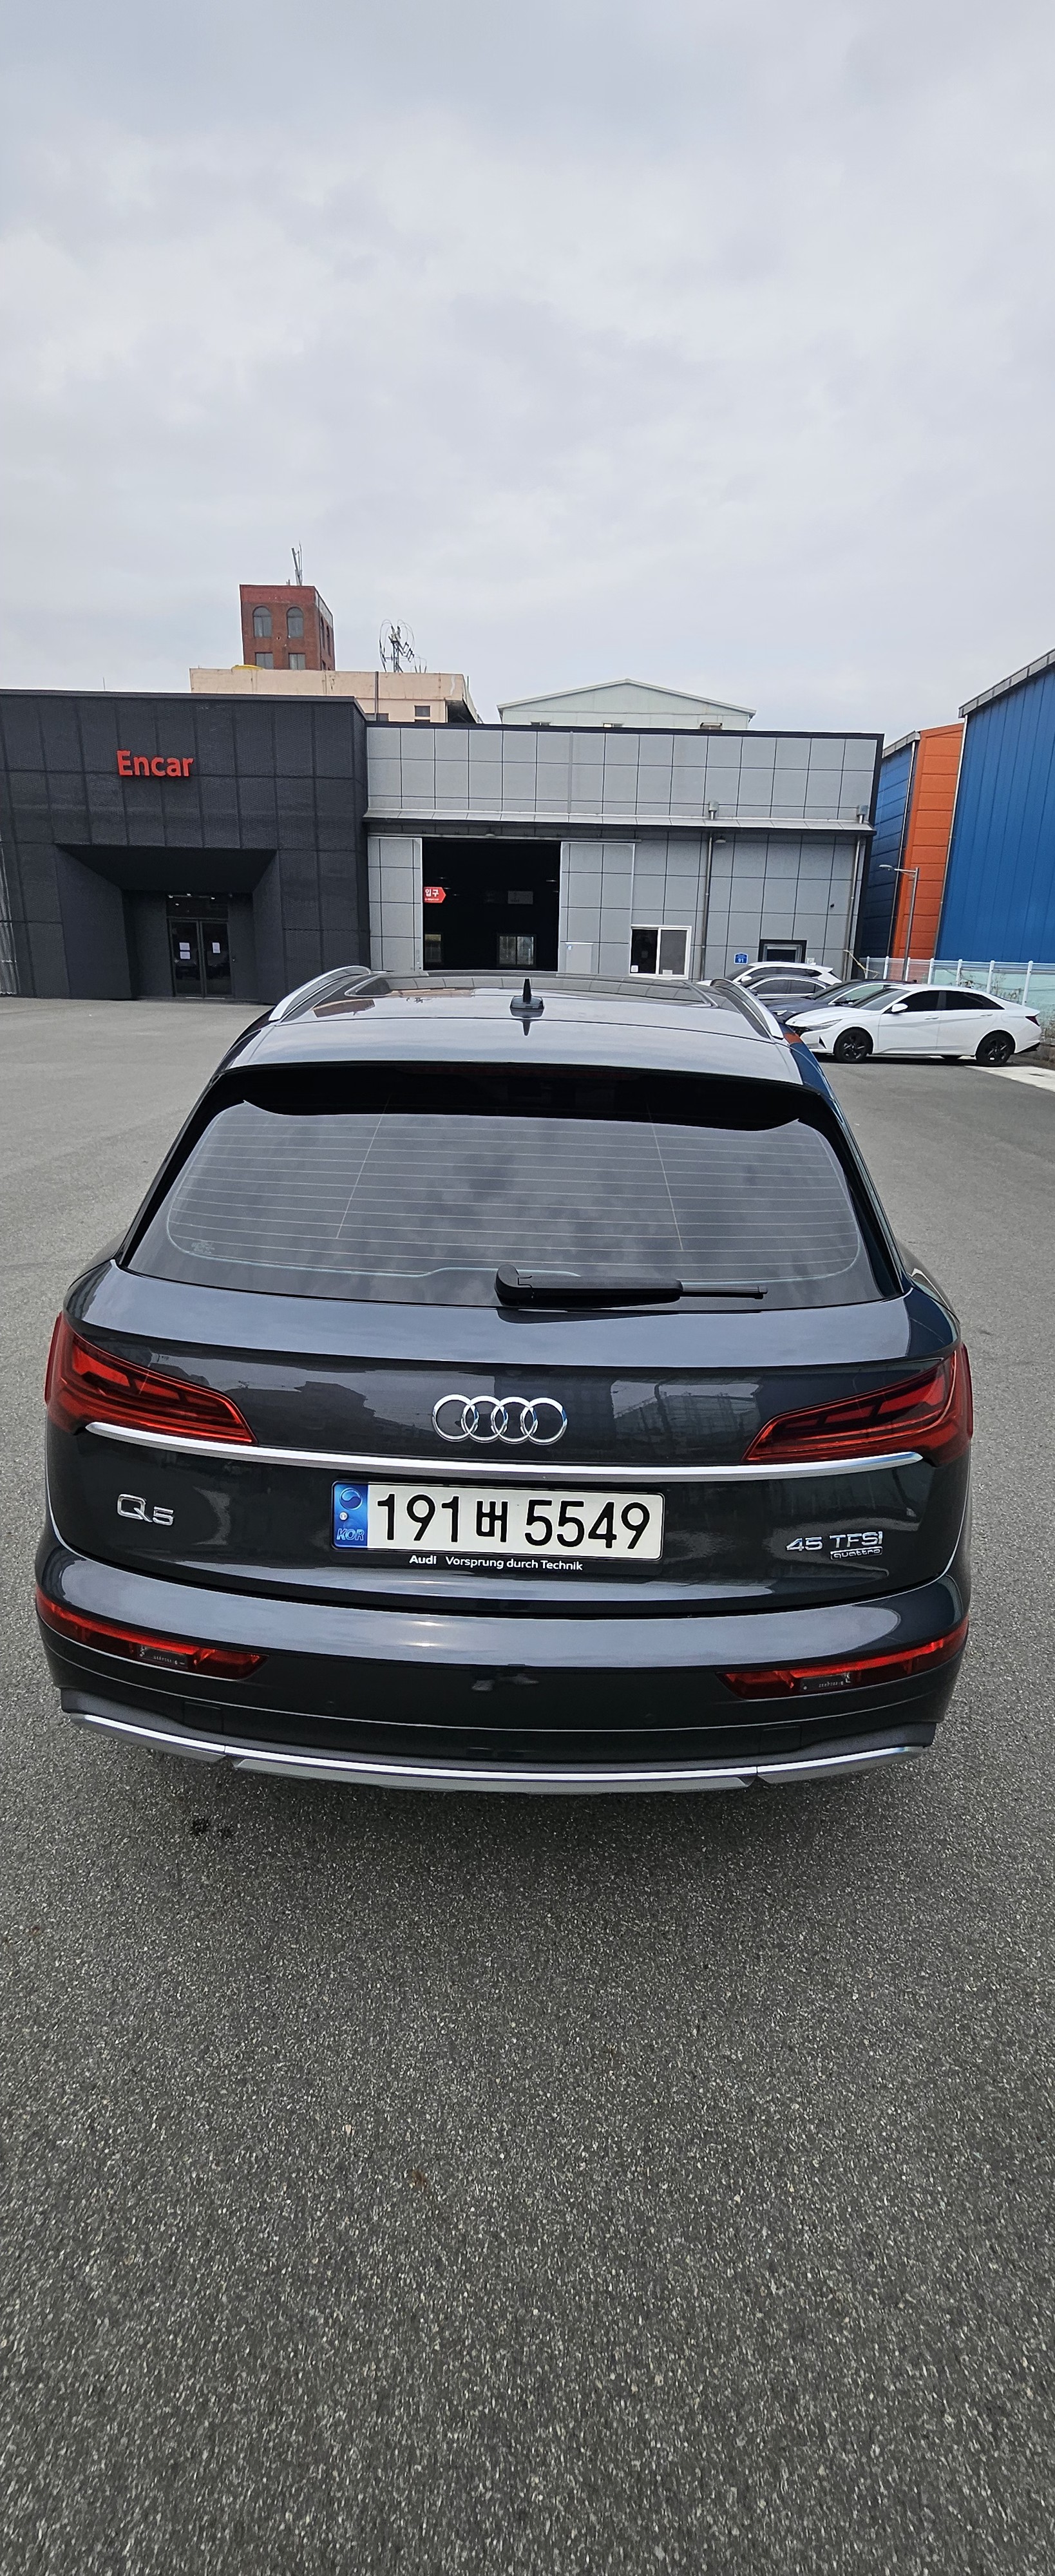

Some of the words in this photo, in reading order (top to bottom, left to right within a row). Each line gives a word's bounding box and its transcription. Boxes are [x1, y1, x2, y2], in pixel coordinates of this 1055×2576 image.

[117, 750, 194, 777] Encar
[425, 889, 439, 897] 입구
[336, 1528, 365, 1541] KOR
[786, 1537, 823, 1551] 45
[829, 1531, 883, 1548] TFSI
[833, 1548, 881, 1558] quattro
[409, 1555, 437, 1564] Audi
[446, 1556, 504, 1569] Vorsprung
[506, 1558, 538, 1569] durch
[540, 1560, 583, 1571] Technik
